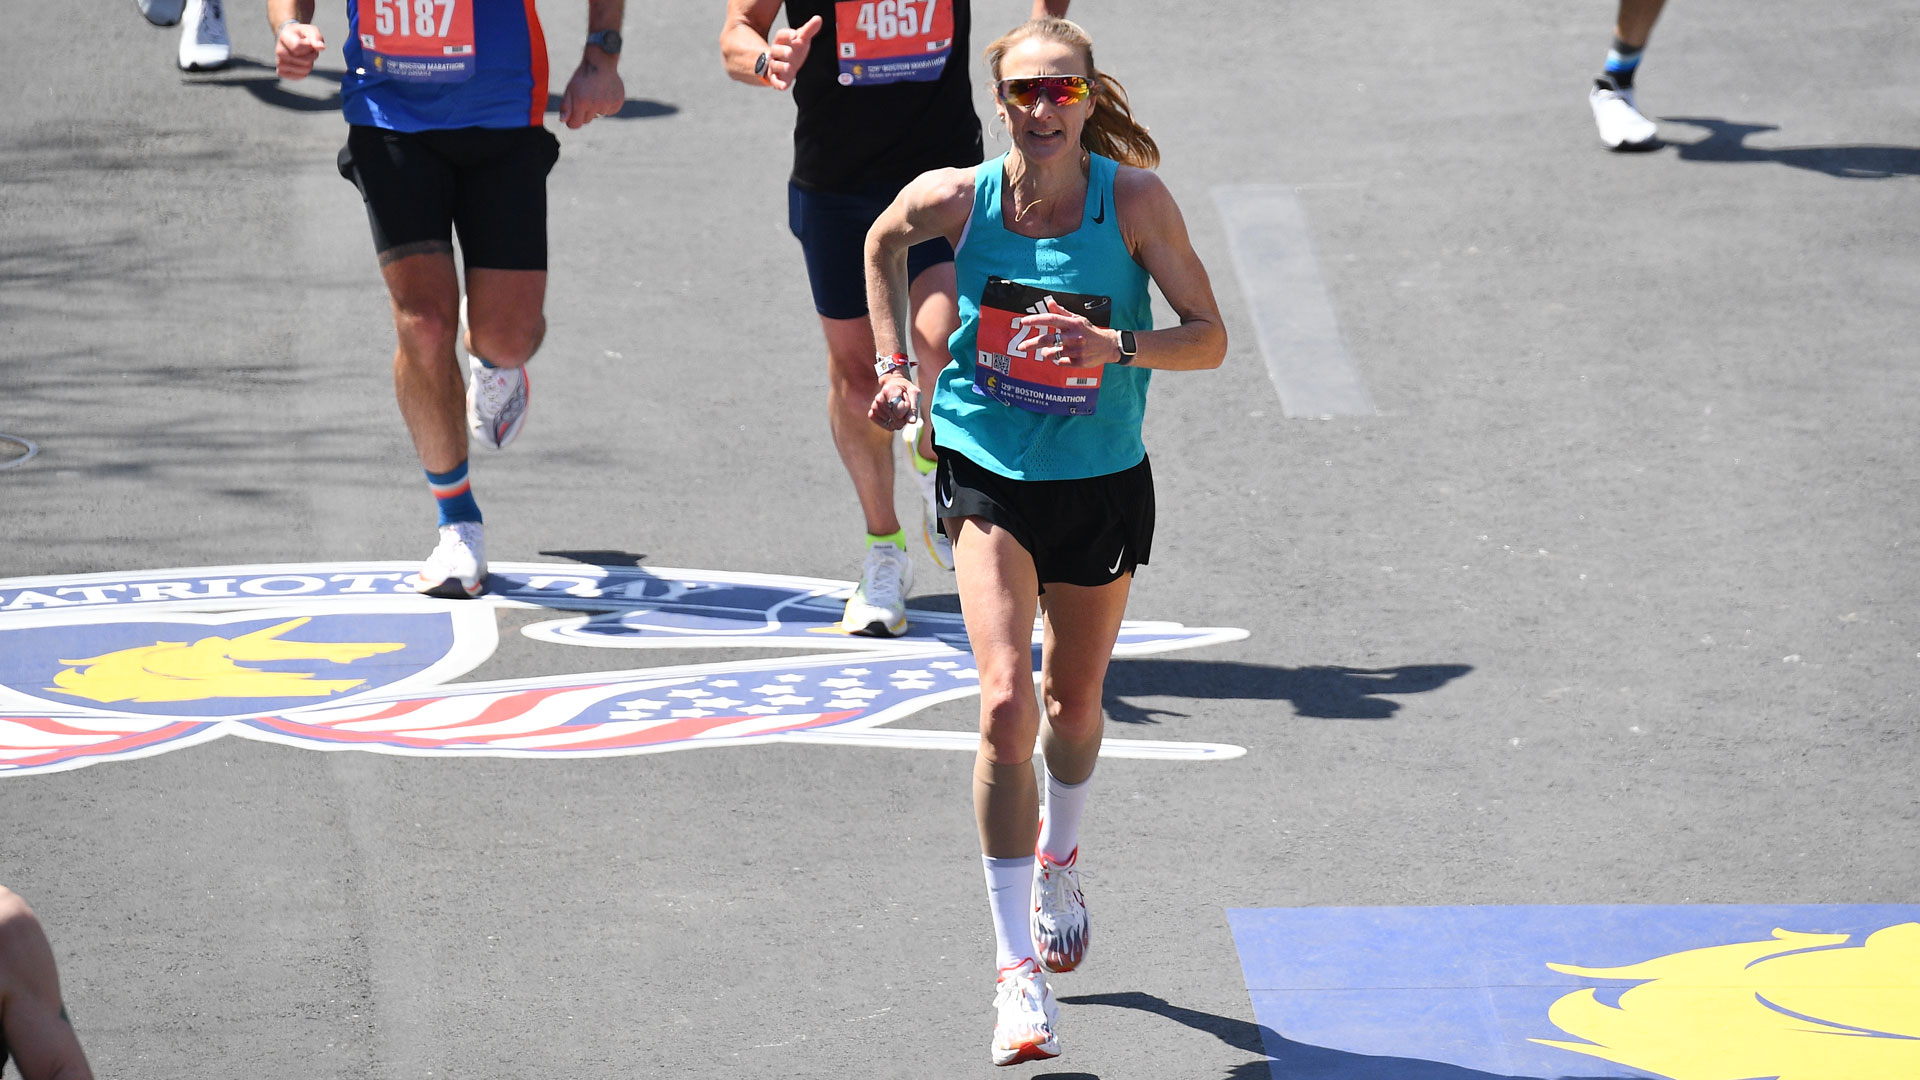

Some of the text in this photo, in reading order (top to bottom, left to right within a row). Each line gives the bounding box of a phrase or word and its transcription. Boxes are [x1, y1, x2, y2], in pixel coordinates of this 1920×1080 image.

[375, 0, 456, 37] 5187
[856, 0, 937, 40] 4657
[1006, 317, 1061, 366] 21
[1015, 386, 1045, 400] BOSTON
[1045, 392, 1086, 403] MARATHON
[1024, 396, 1049, 406] AMERICA
